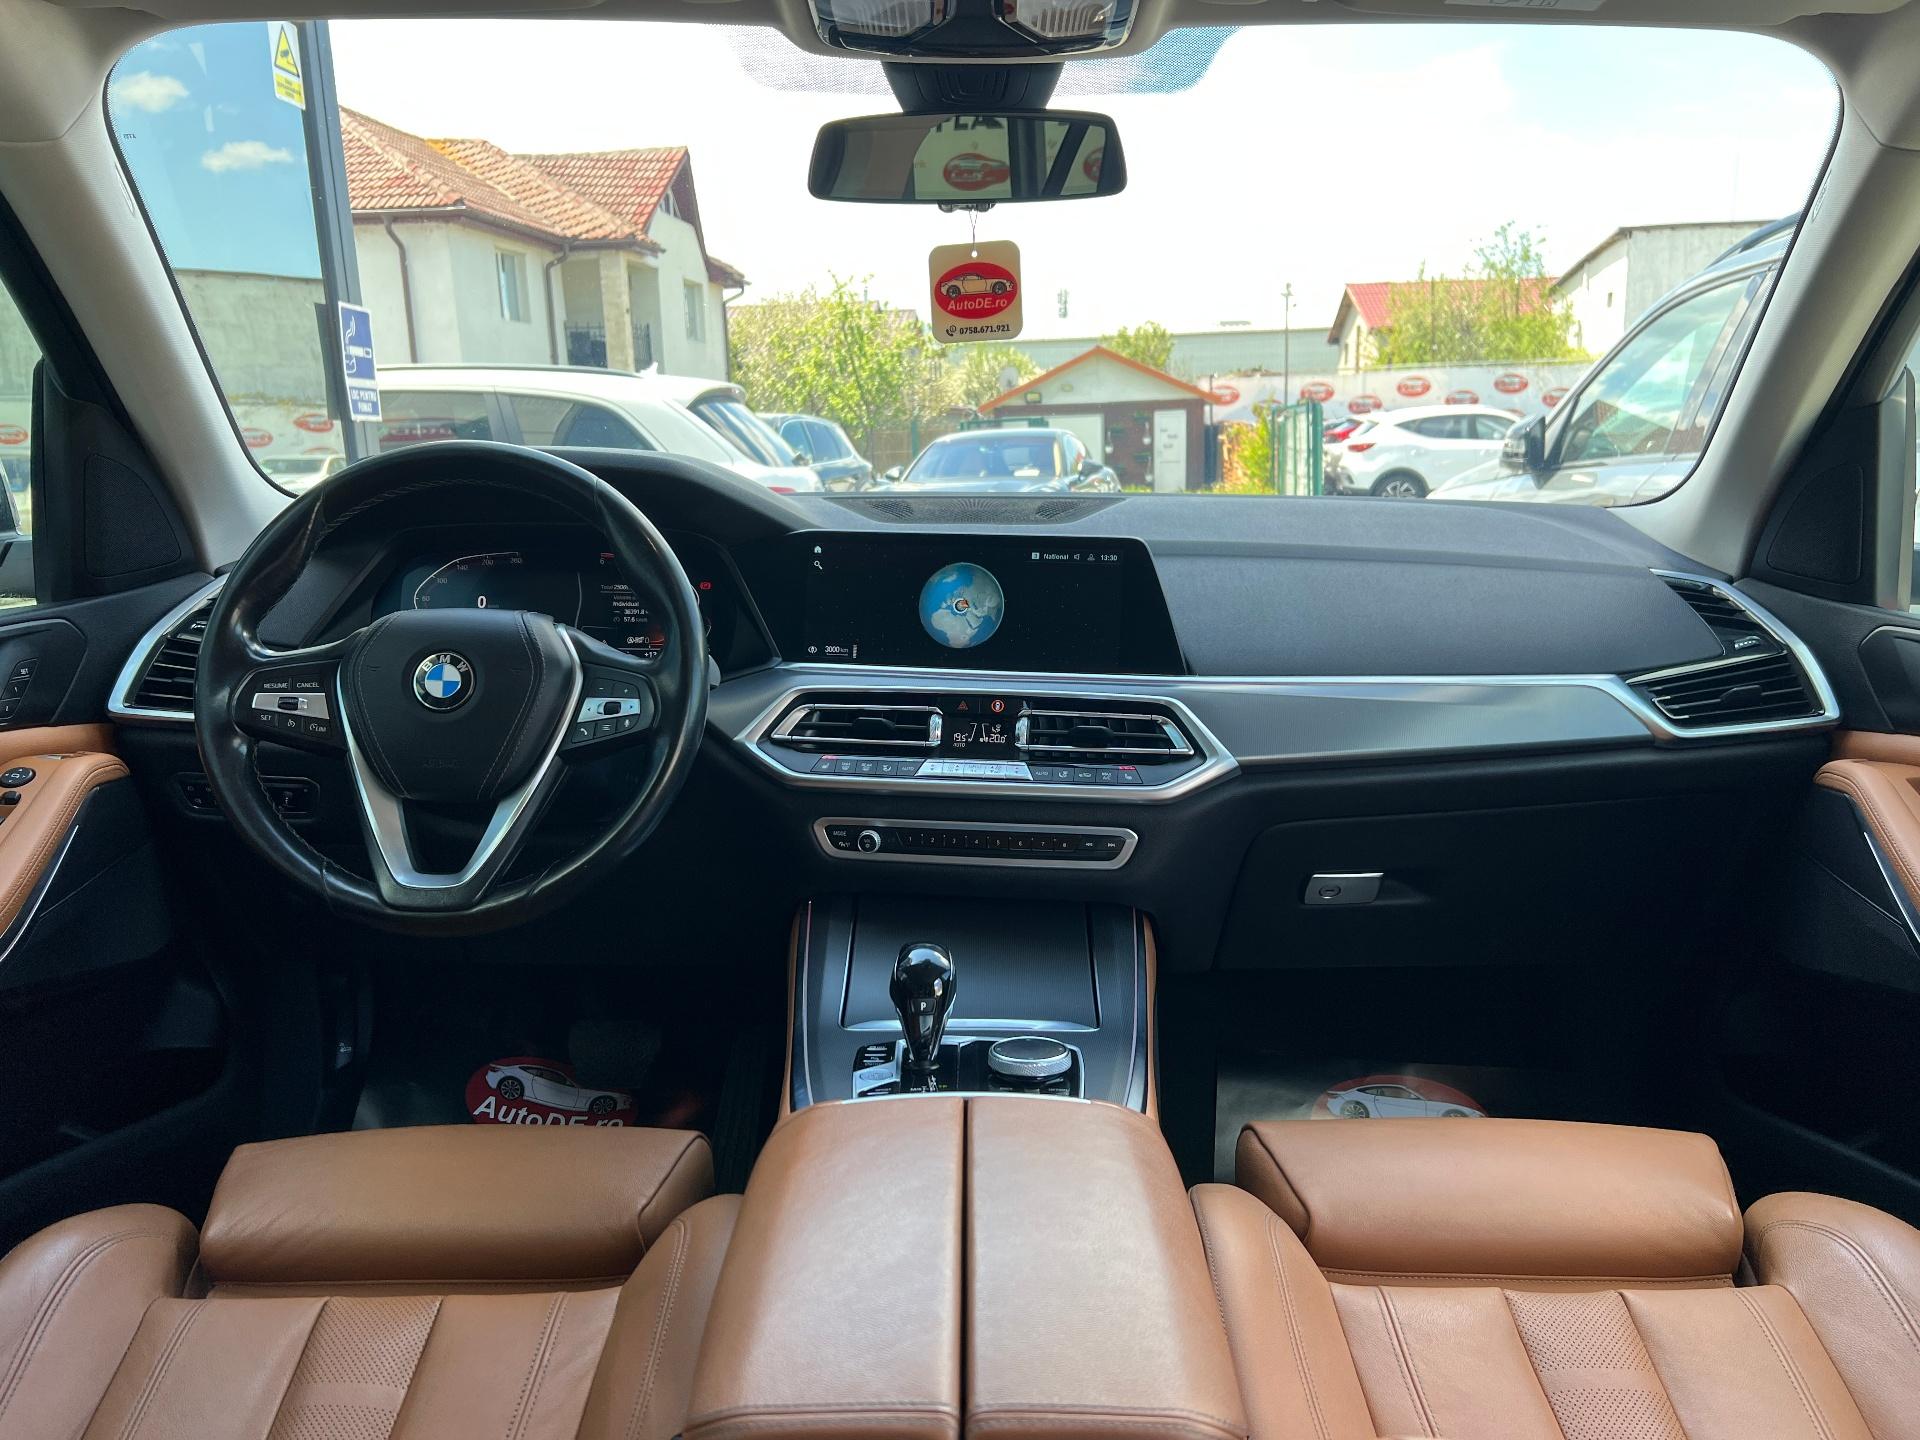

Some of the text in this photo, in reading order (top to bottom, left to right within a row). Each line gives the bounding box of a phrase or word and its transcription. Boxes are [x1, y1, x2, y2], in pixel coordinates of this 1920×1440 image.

[947, 297, 1008, 311] AutoDE.ro
[959, 324, 1011, 335] 0758.671.921
[477, 595, 487, 609] 0
[824, 645, 840, 653] 3000
[421, 654, 469, 673] BMW
[920, 1001, 927, 1011] P
[473, 1095, 625, 1128] AutoDEro
